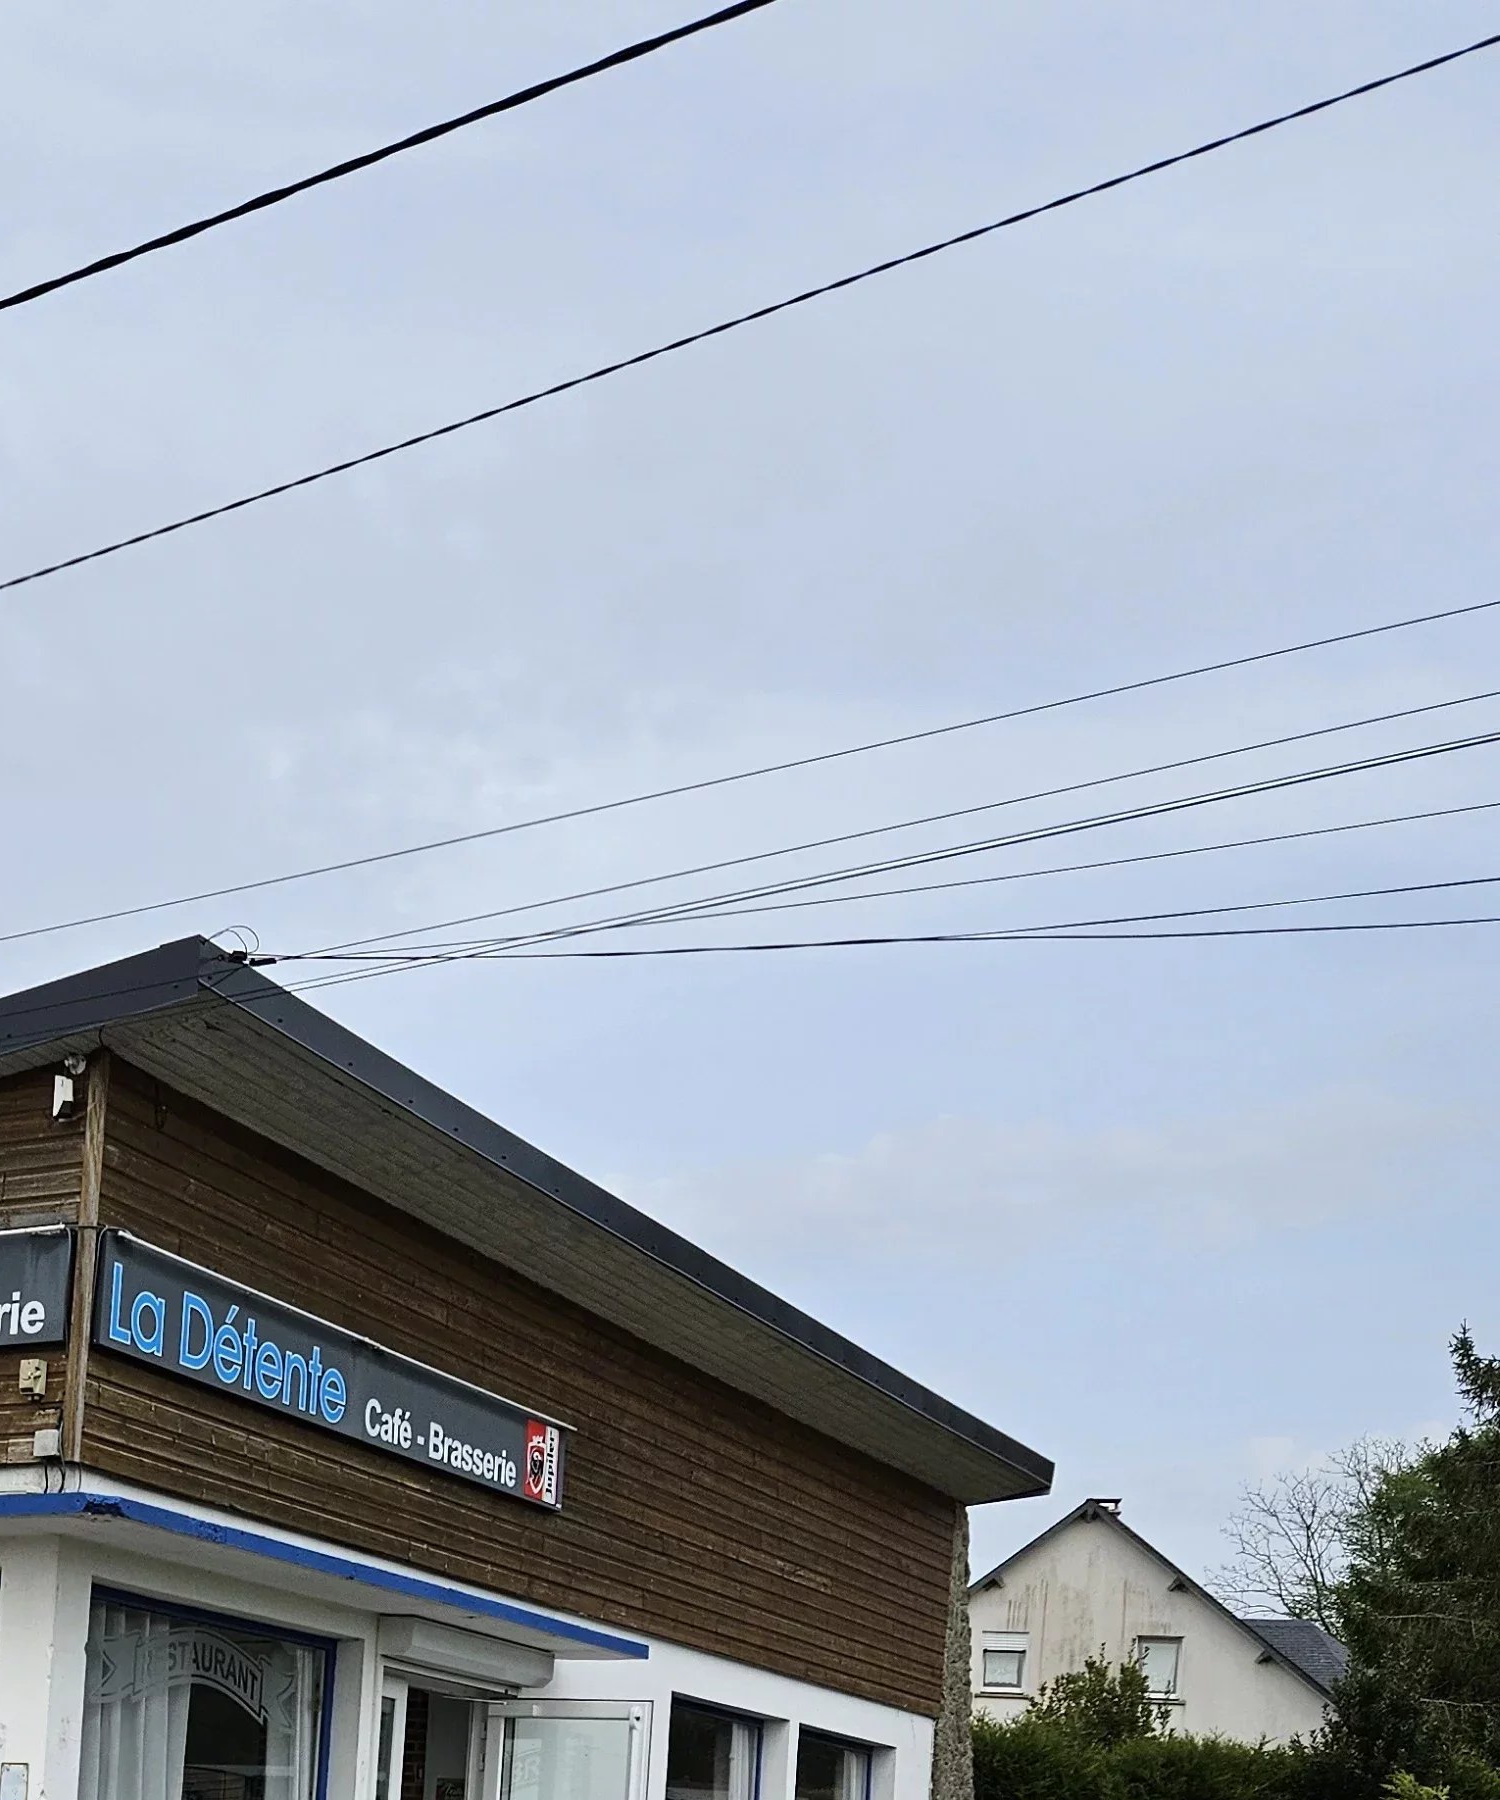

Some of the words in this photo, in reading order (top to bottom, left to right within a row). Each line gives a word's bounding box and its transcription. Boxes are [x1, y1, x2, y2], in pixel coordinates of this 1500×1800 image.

[109, 1261, 165, 1357] La
[179, 1290, 347, 1424] Détente
[365, 1398, 412, 1449] Café
[428, 1421, 517, 1488] Brasserie
